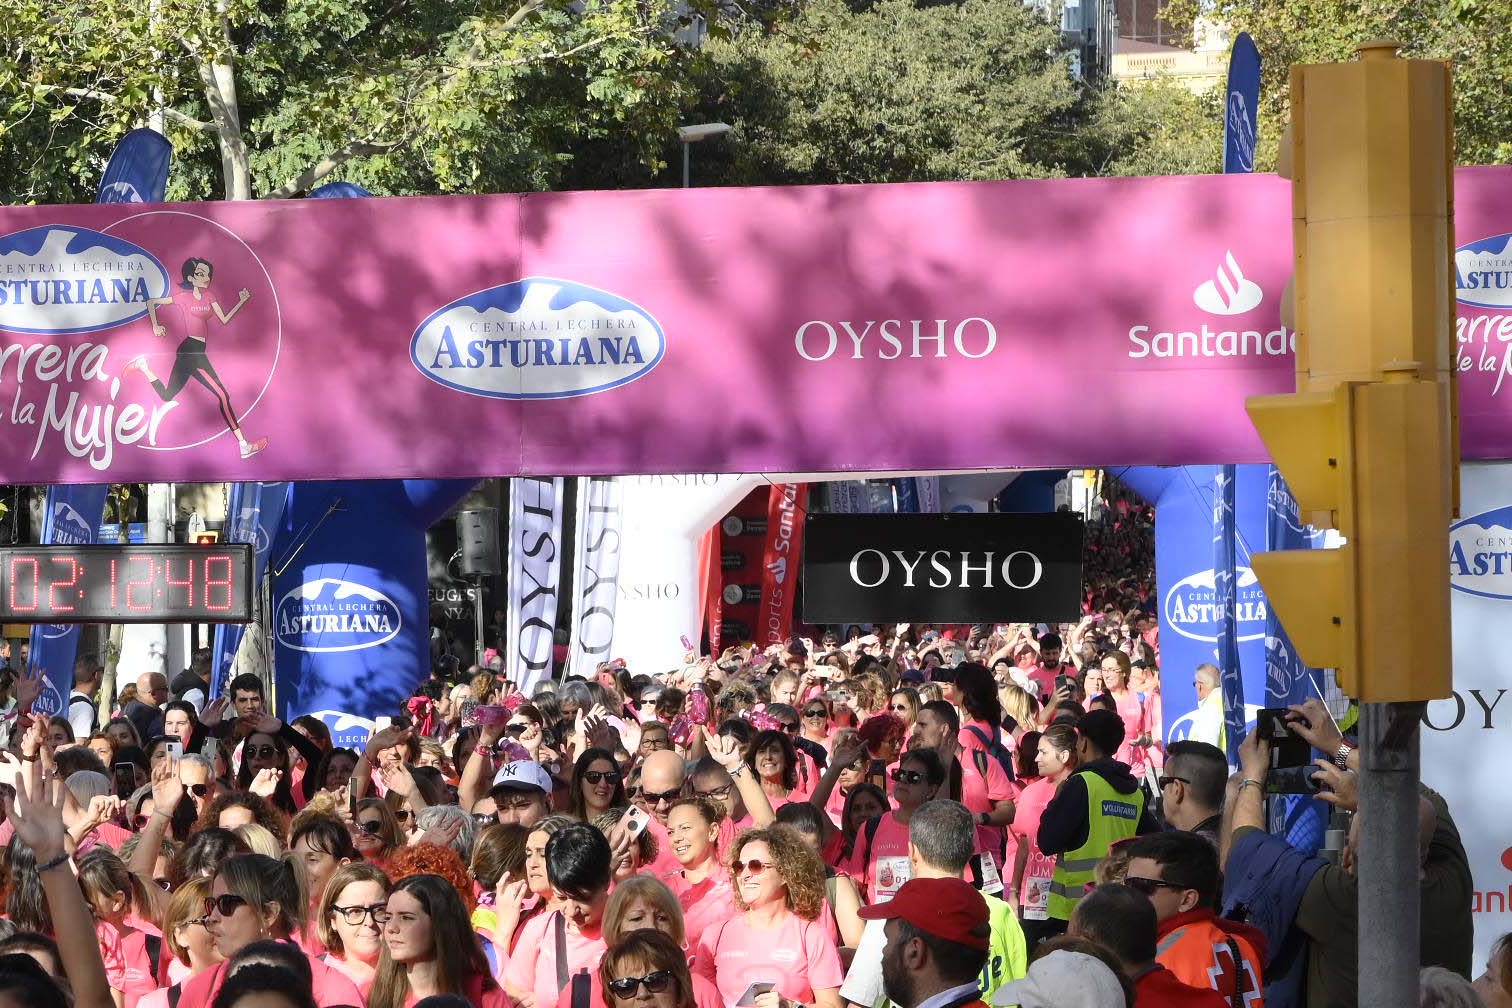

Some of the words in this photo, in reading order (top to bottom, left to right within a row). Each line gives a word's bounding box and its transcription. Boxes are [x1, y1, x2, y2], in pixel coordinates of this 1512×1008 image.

[73, 259, 145, 273] LECHERA
[469, 320, 549, 333] CENTRAL
[556, 318, 637, 331] LECHERA
[794, 316, 998, 361] OYSHO
[1128, 325, 1297, 360] Santand
[430, 324, 646, 370] ASTURIANA
[11, 386, 36, 426] la
[30, 377, 179, 471] Mujer
[10, 555, 233, 611] 02:12:48
[849, 548, 1043, 590] OYSHO
[279, 613, 393, 636] ASTURIANA
[292, 603, 335, 612] CENTRAL
[338, 603, 388, 612] LECHERA
